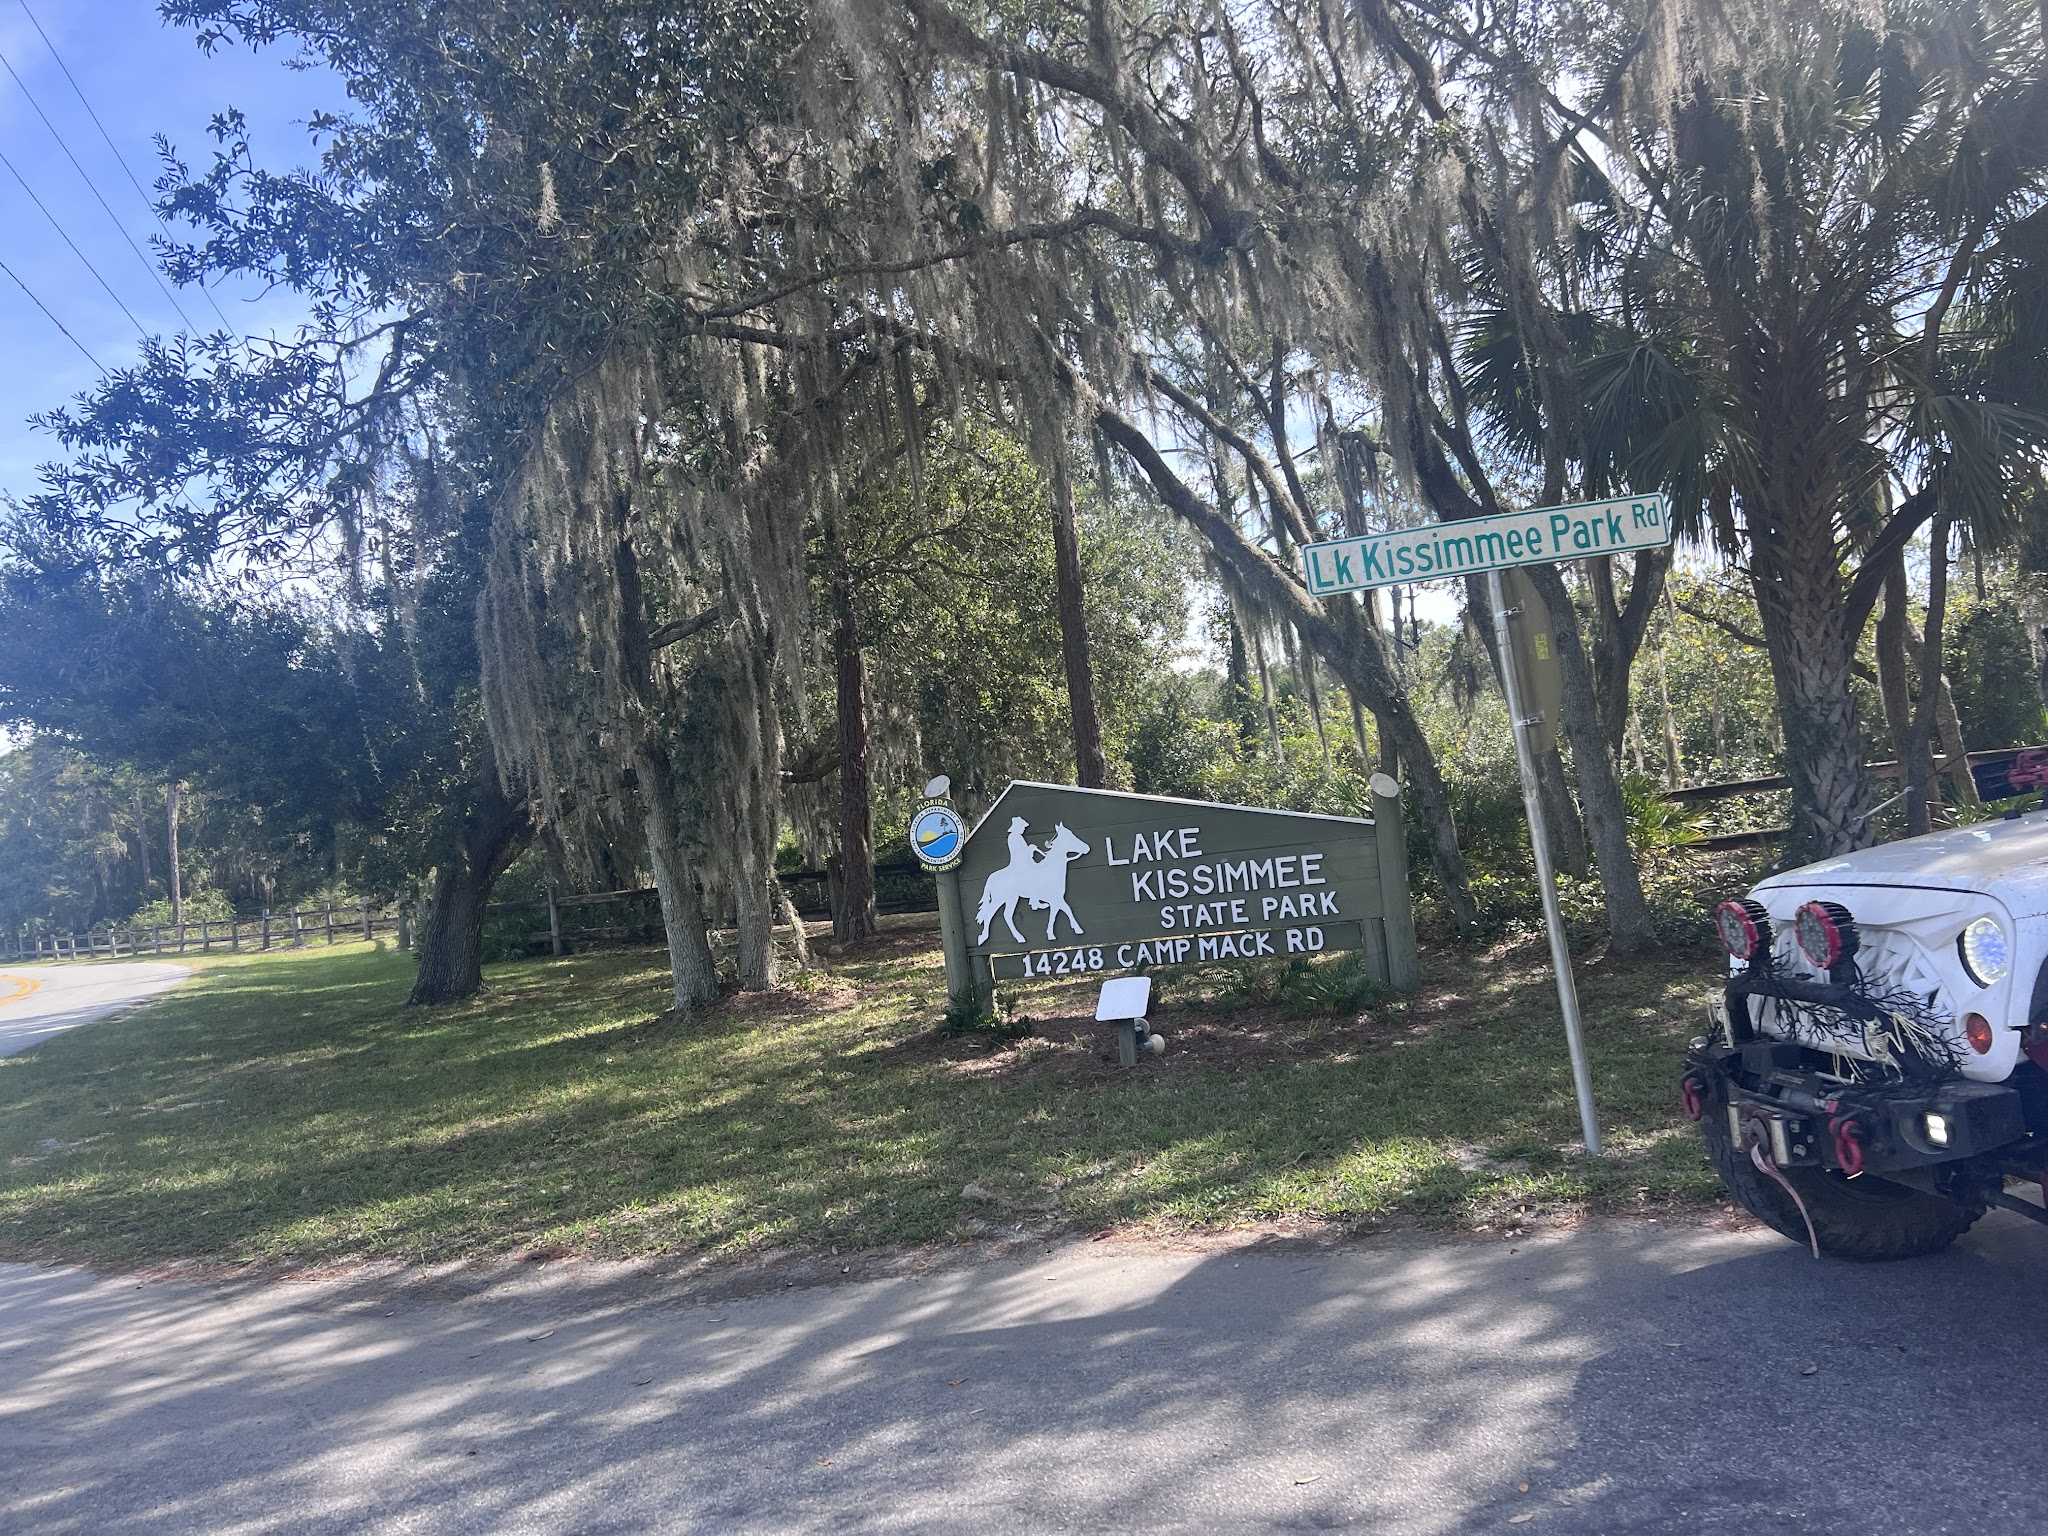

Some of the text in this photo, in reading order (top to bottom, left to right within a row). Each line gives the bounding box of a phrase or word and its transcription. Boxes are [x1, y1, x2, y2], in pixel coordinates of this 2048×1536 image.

[1311, 502, 1660, 588] Lk Kissimmee Park Rd
[916, 798, 948, 812] FLORIDA
[920, 857, 962, 872] PARK SERVICE
[1105, 827, 1203, 866] LAKE
[1131, 853, 1327, 902] KISSIMMEE
[1160, 890, 1340, 929] STATE PARK
[1022, 926, 1325, 978] 14248 CAMP MACK RD
